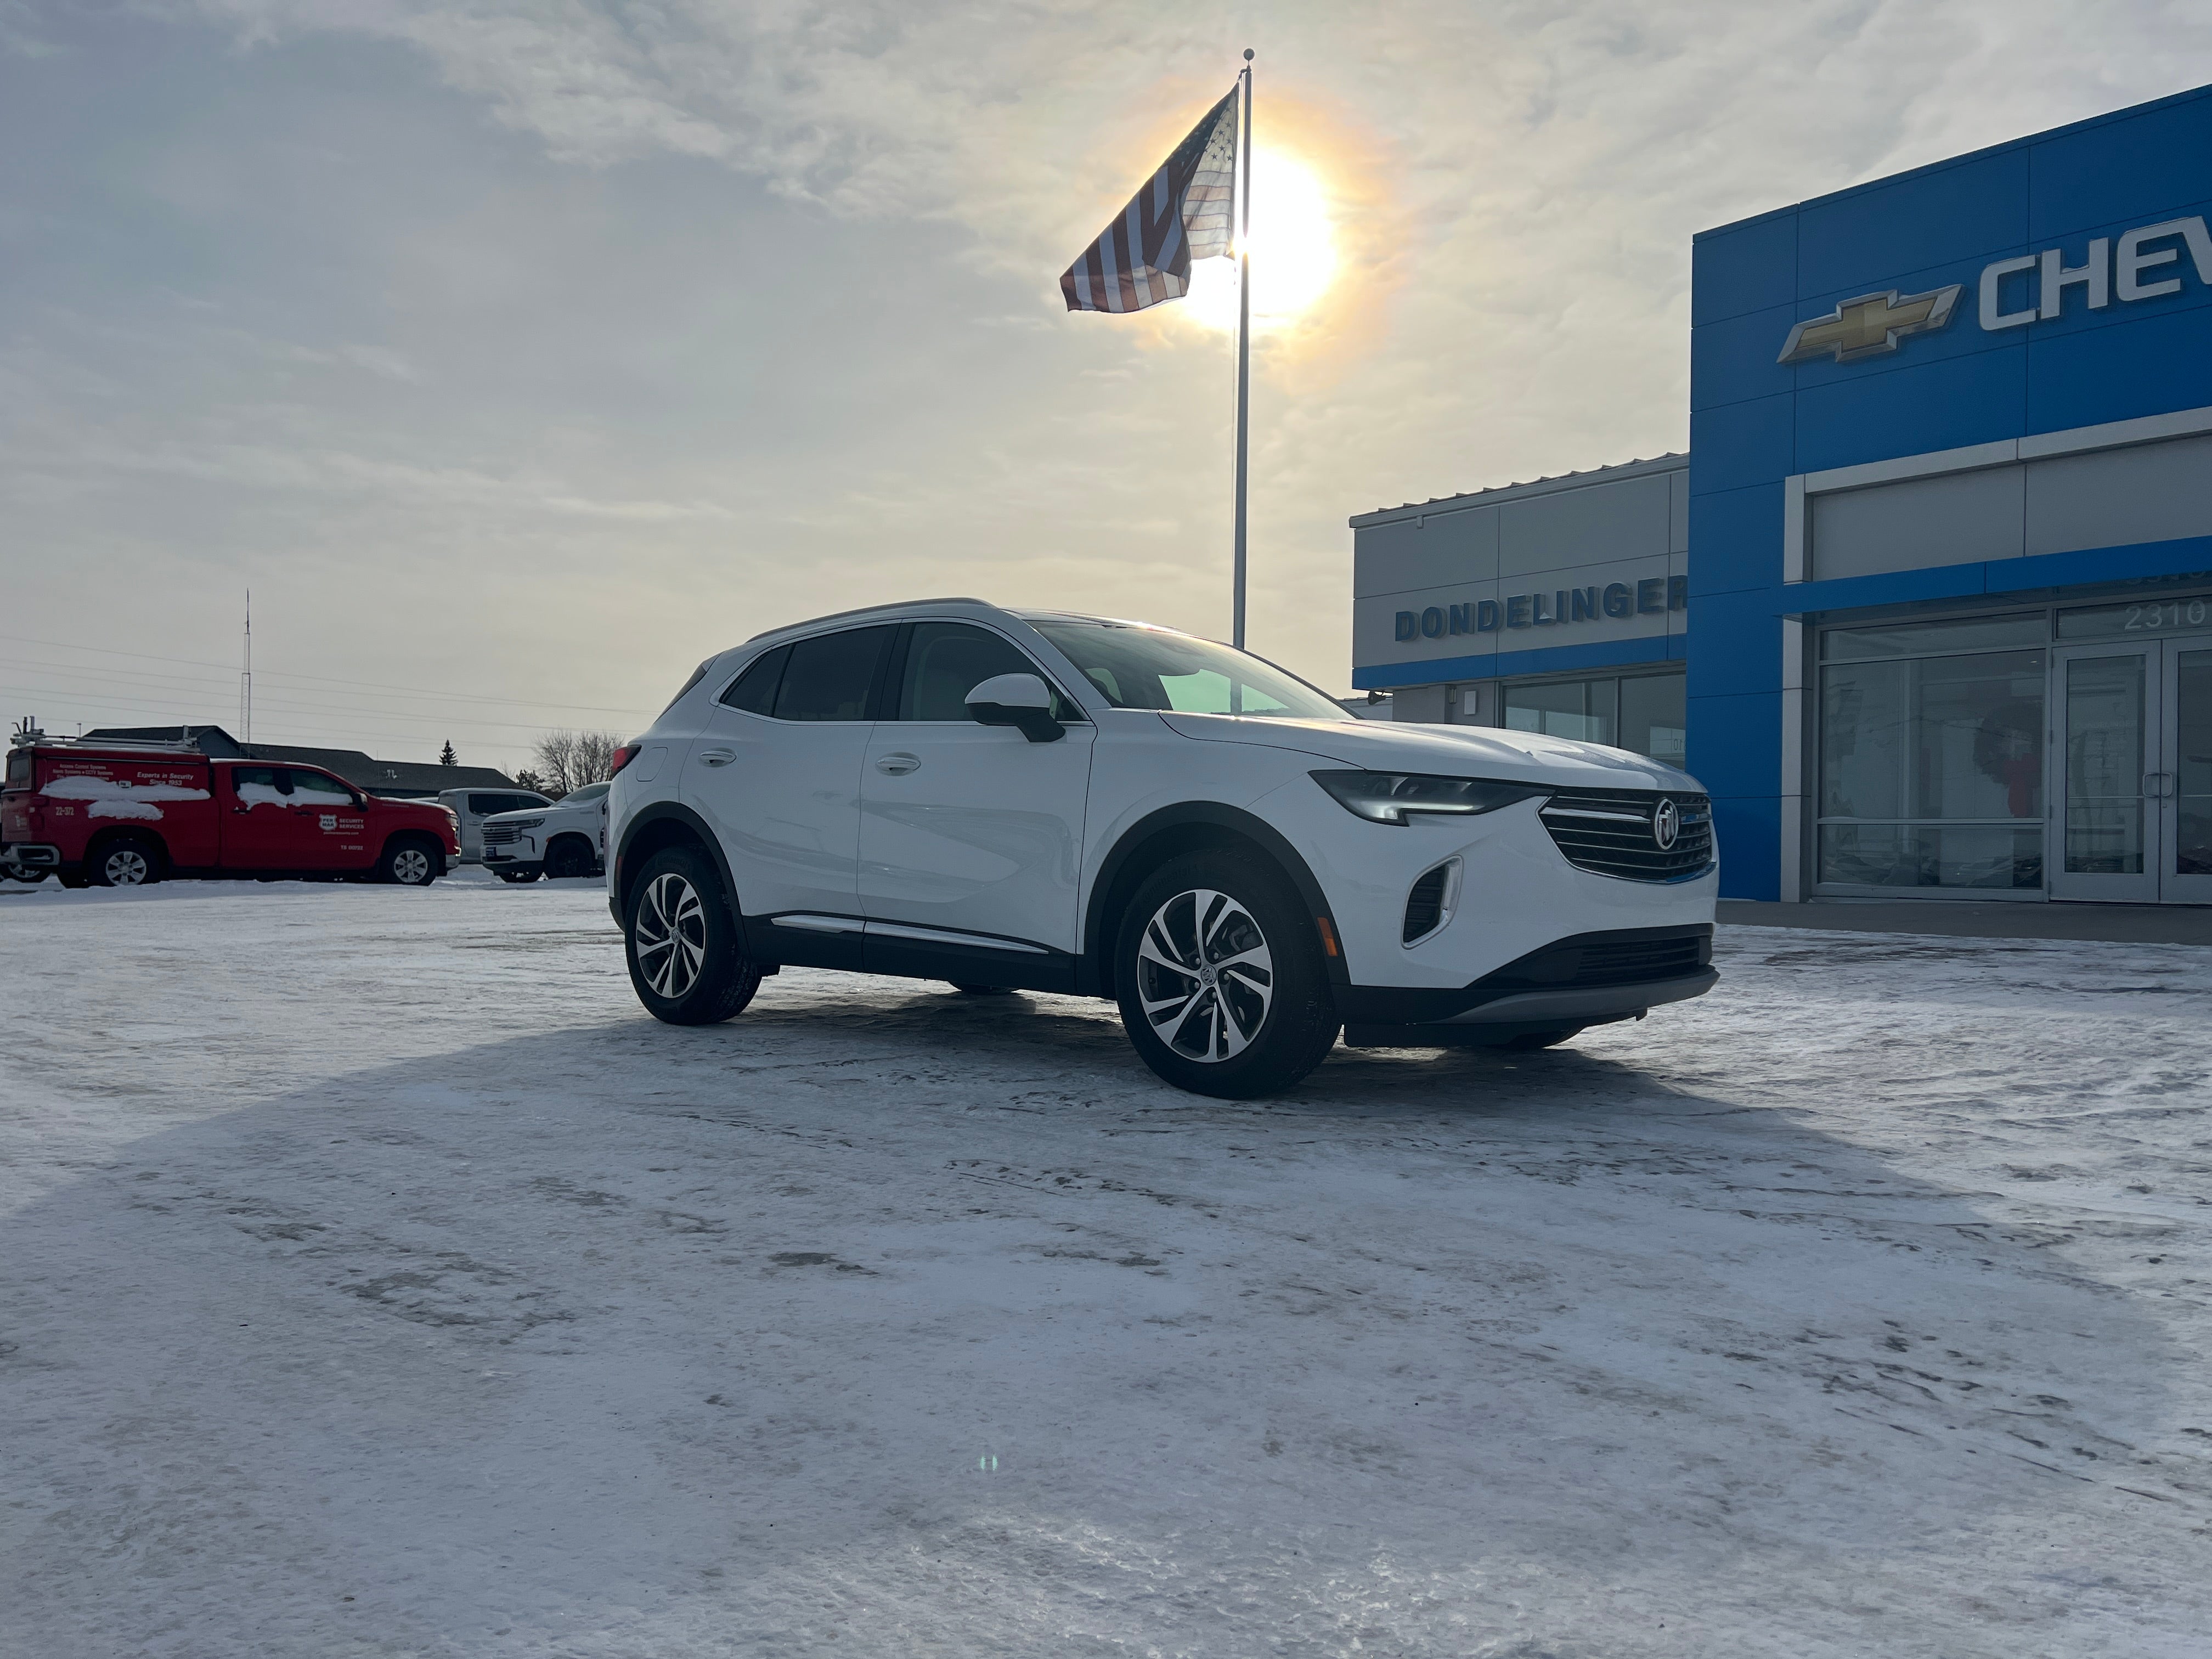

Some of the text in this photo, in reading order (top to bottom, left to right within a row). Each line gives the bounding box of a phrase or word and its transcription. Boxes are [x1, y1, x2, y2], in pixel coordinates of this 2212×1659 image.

[1395, 574, 1689, 642] DONDELINGER
[2124, 597, 2205, 630] 2310
[55, 806, 75, 816] 22-372
